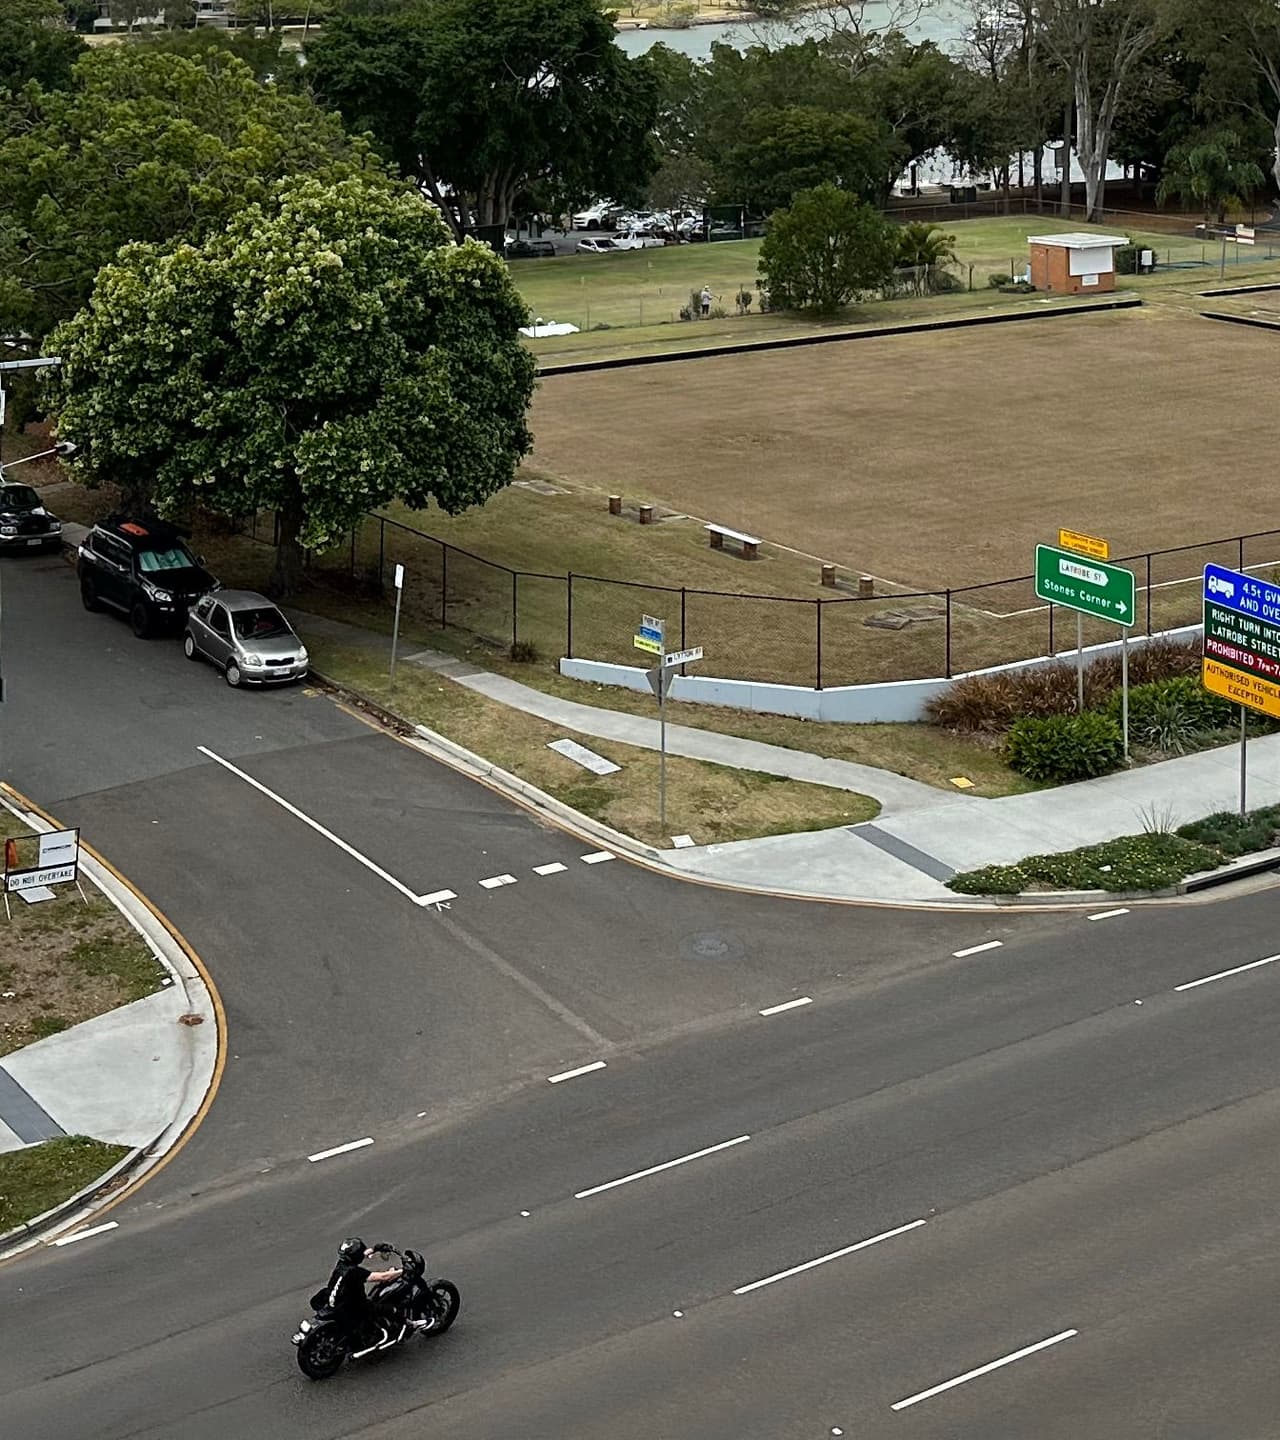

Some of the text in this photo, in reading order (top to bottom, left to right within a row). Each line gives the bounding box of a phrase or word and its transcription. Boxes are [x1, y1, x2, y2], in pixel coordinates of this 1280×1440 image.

[1061, 562, 1090, 578] LATROBE
[1044, 578, 1112, 608] Stones Corner
[1242, 582, 1261, 599] 4.5t
[1240, 596, 1259, 612] AND
[1211, 608, 1236, 626] RIGHT
[1238, 617, 1261, 635] TURN
[1211, 623, 1248, 647] LATROBE
[1206, 638, 1254, 666] PROHIBITED
[1206, 663, 1250, 687] AUTHORISED
[1227, 684, 1265, 706] EXCEPTED
[10, 869, 73, 887] DO NOT OVERTAKE
